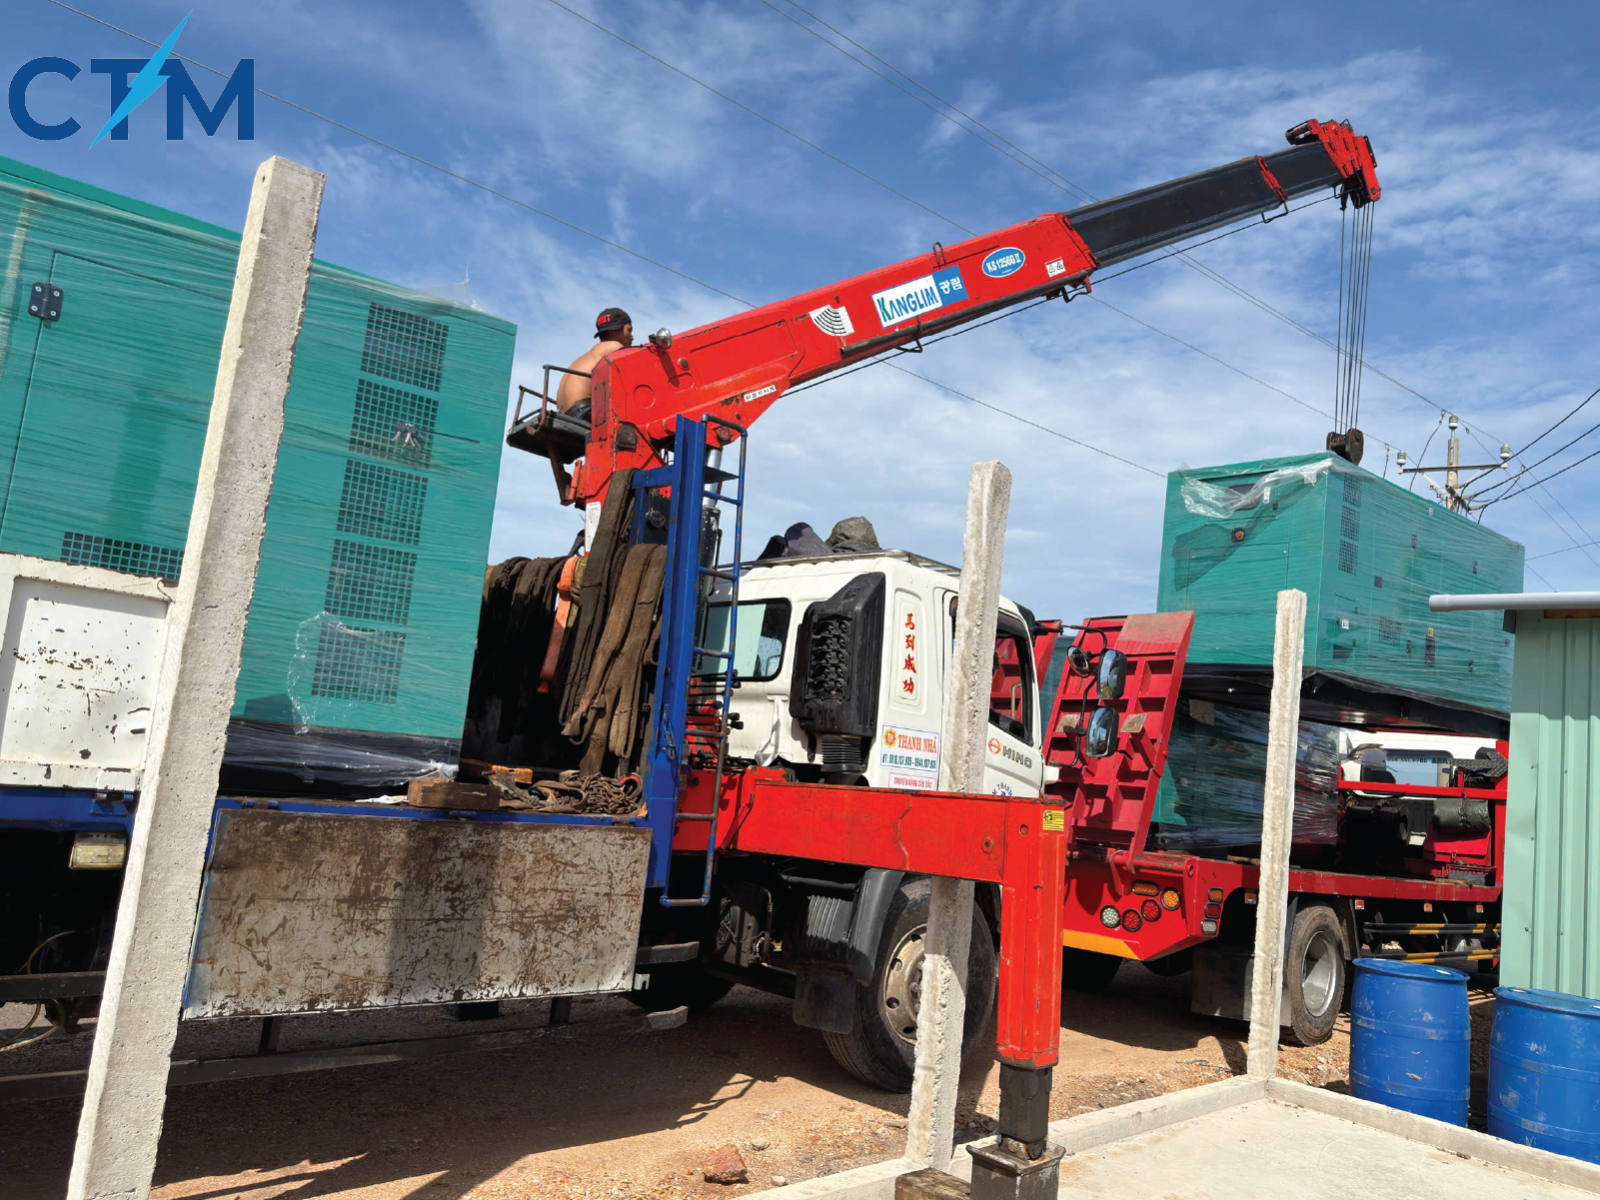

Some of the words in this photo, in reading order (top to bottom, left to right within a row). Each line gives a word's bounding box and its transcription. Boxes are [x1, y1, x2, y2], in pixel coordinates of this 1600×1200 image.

[939, 276, 963, 295] 광림
[876, 286, 939, 323] KANGLIM
[898, 734, 922, 751] THANH
[1002, 745, 1033, 769] HINO
